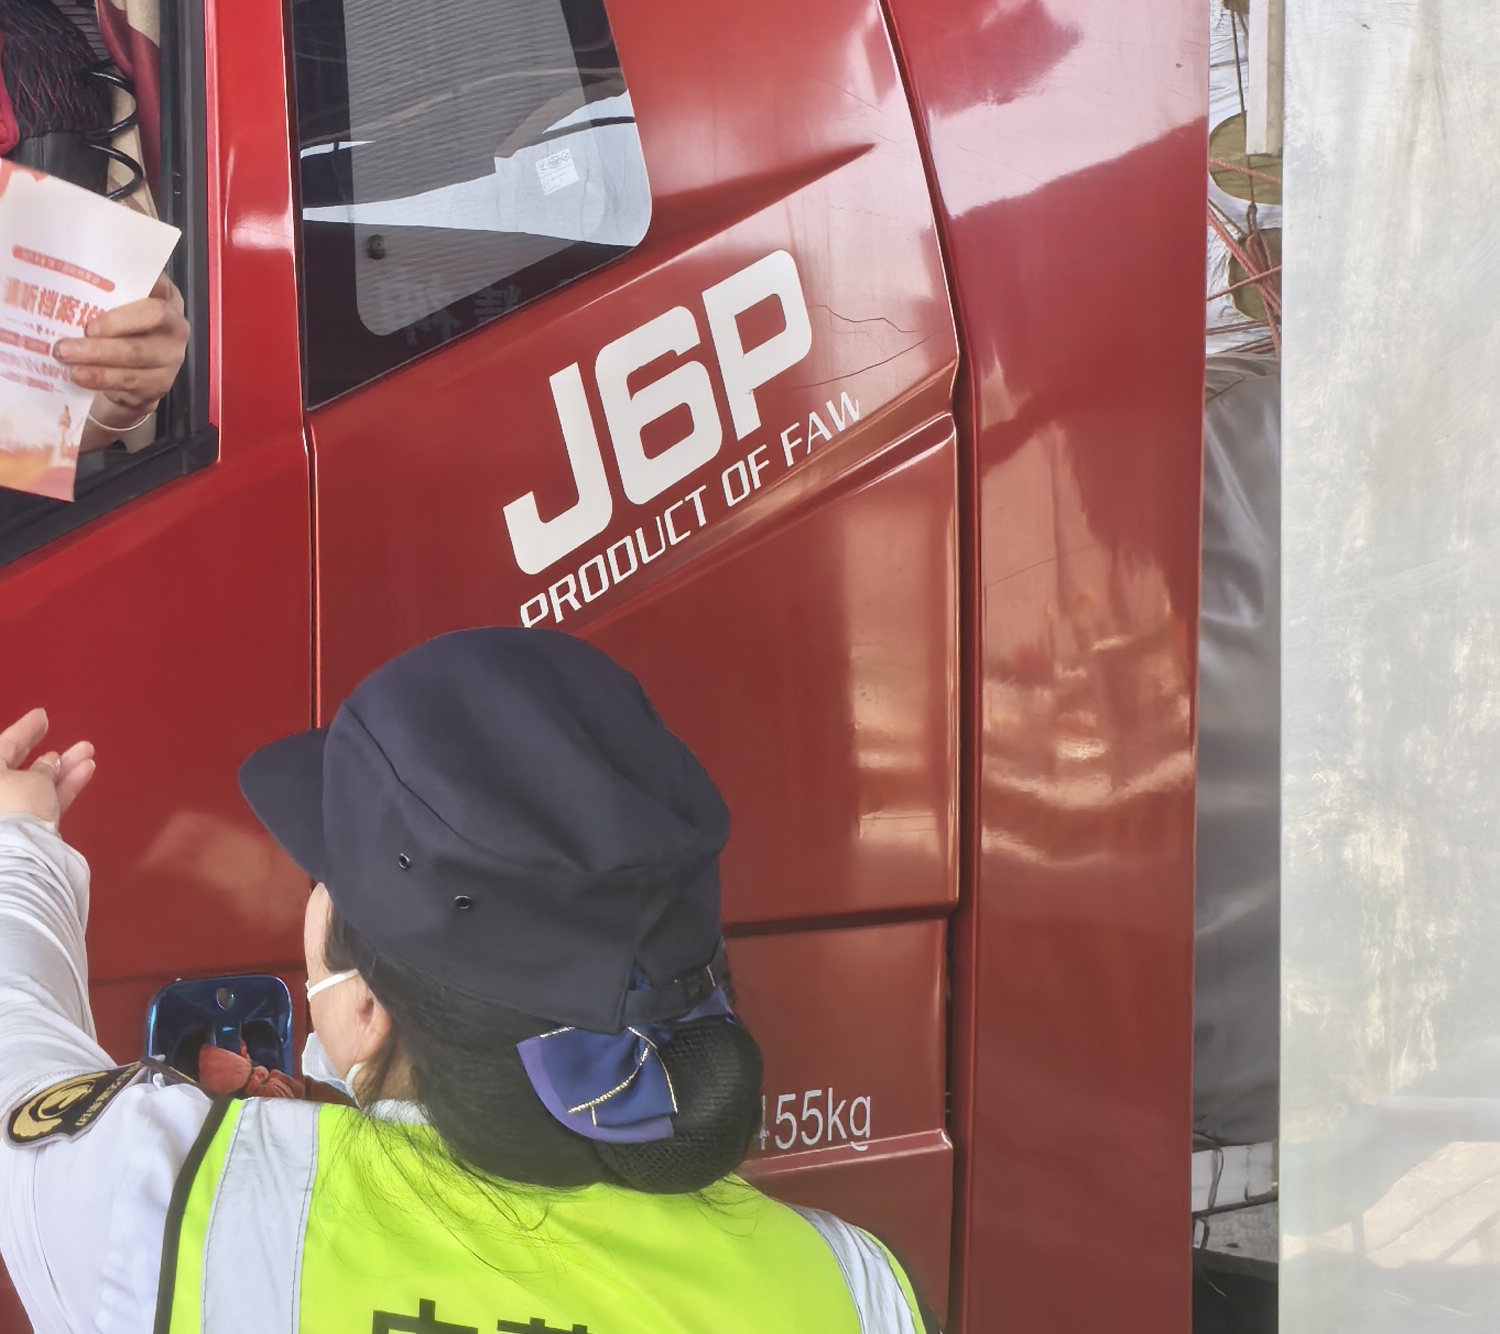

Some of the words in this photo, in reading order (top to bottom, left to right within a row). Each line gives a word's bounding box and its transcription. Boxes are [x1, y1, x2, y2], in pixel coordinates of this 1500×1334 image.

[502, 249, 813, 575] J6P
[519, 484, 707, 628] PRODUCT
[720, 444, 770, 507] OF
[779, 391, 861, 467] FAW
